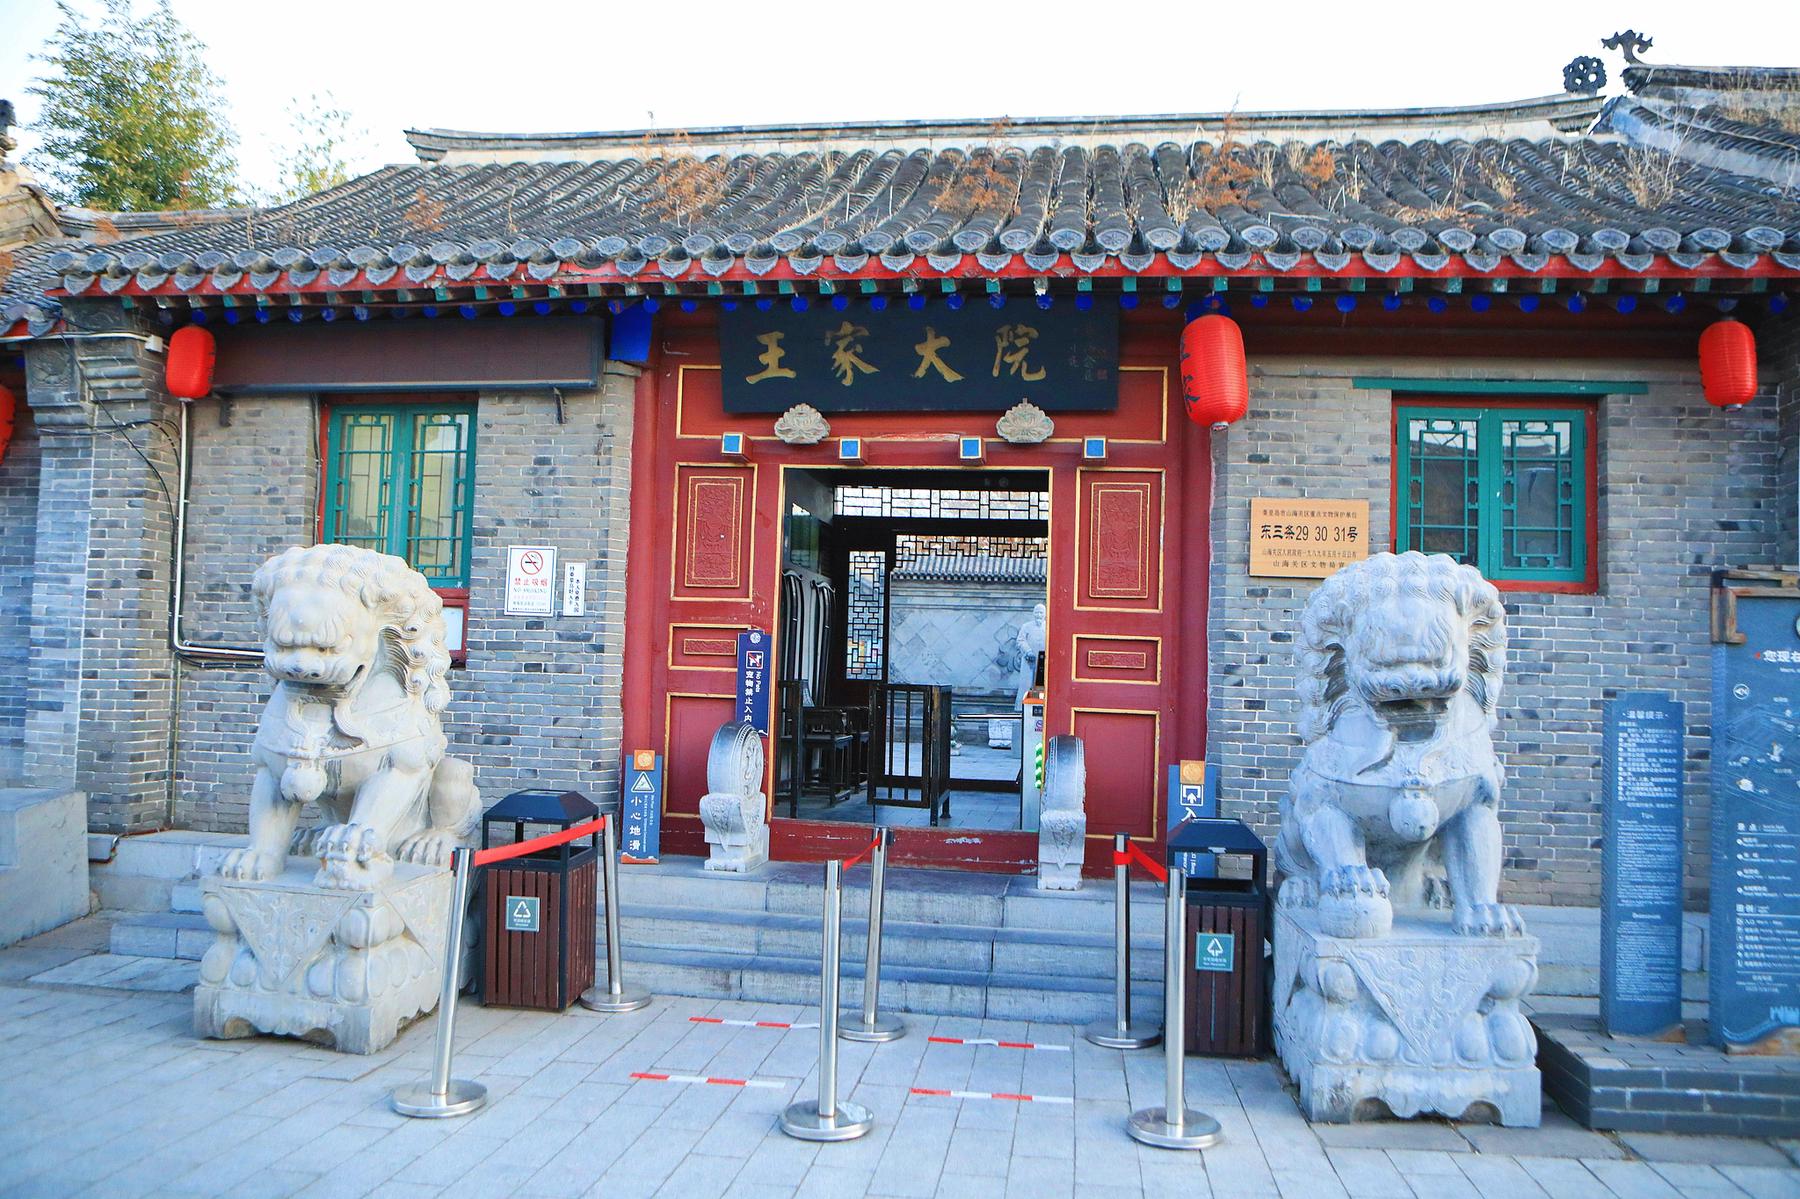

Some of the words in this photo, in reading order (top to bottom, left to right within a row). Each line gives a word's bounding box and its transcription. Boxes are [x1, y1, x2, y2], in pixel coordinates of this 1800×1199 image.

[746, 321, 1046, 386] 王家大院
[1261, 524, 1309, 541] 东三条29
[1315, 526, 1328, 542] 30
[1333, 526, 1358, 543] 31号
[514, 577, 548, 587] 禁止吸烟
[755, 671, 762, 680] No
[744, 670, 754, 723] 宠物禁止入内
[629, 796, 642, 851] 小心地滑
